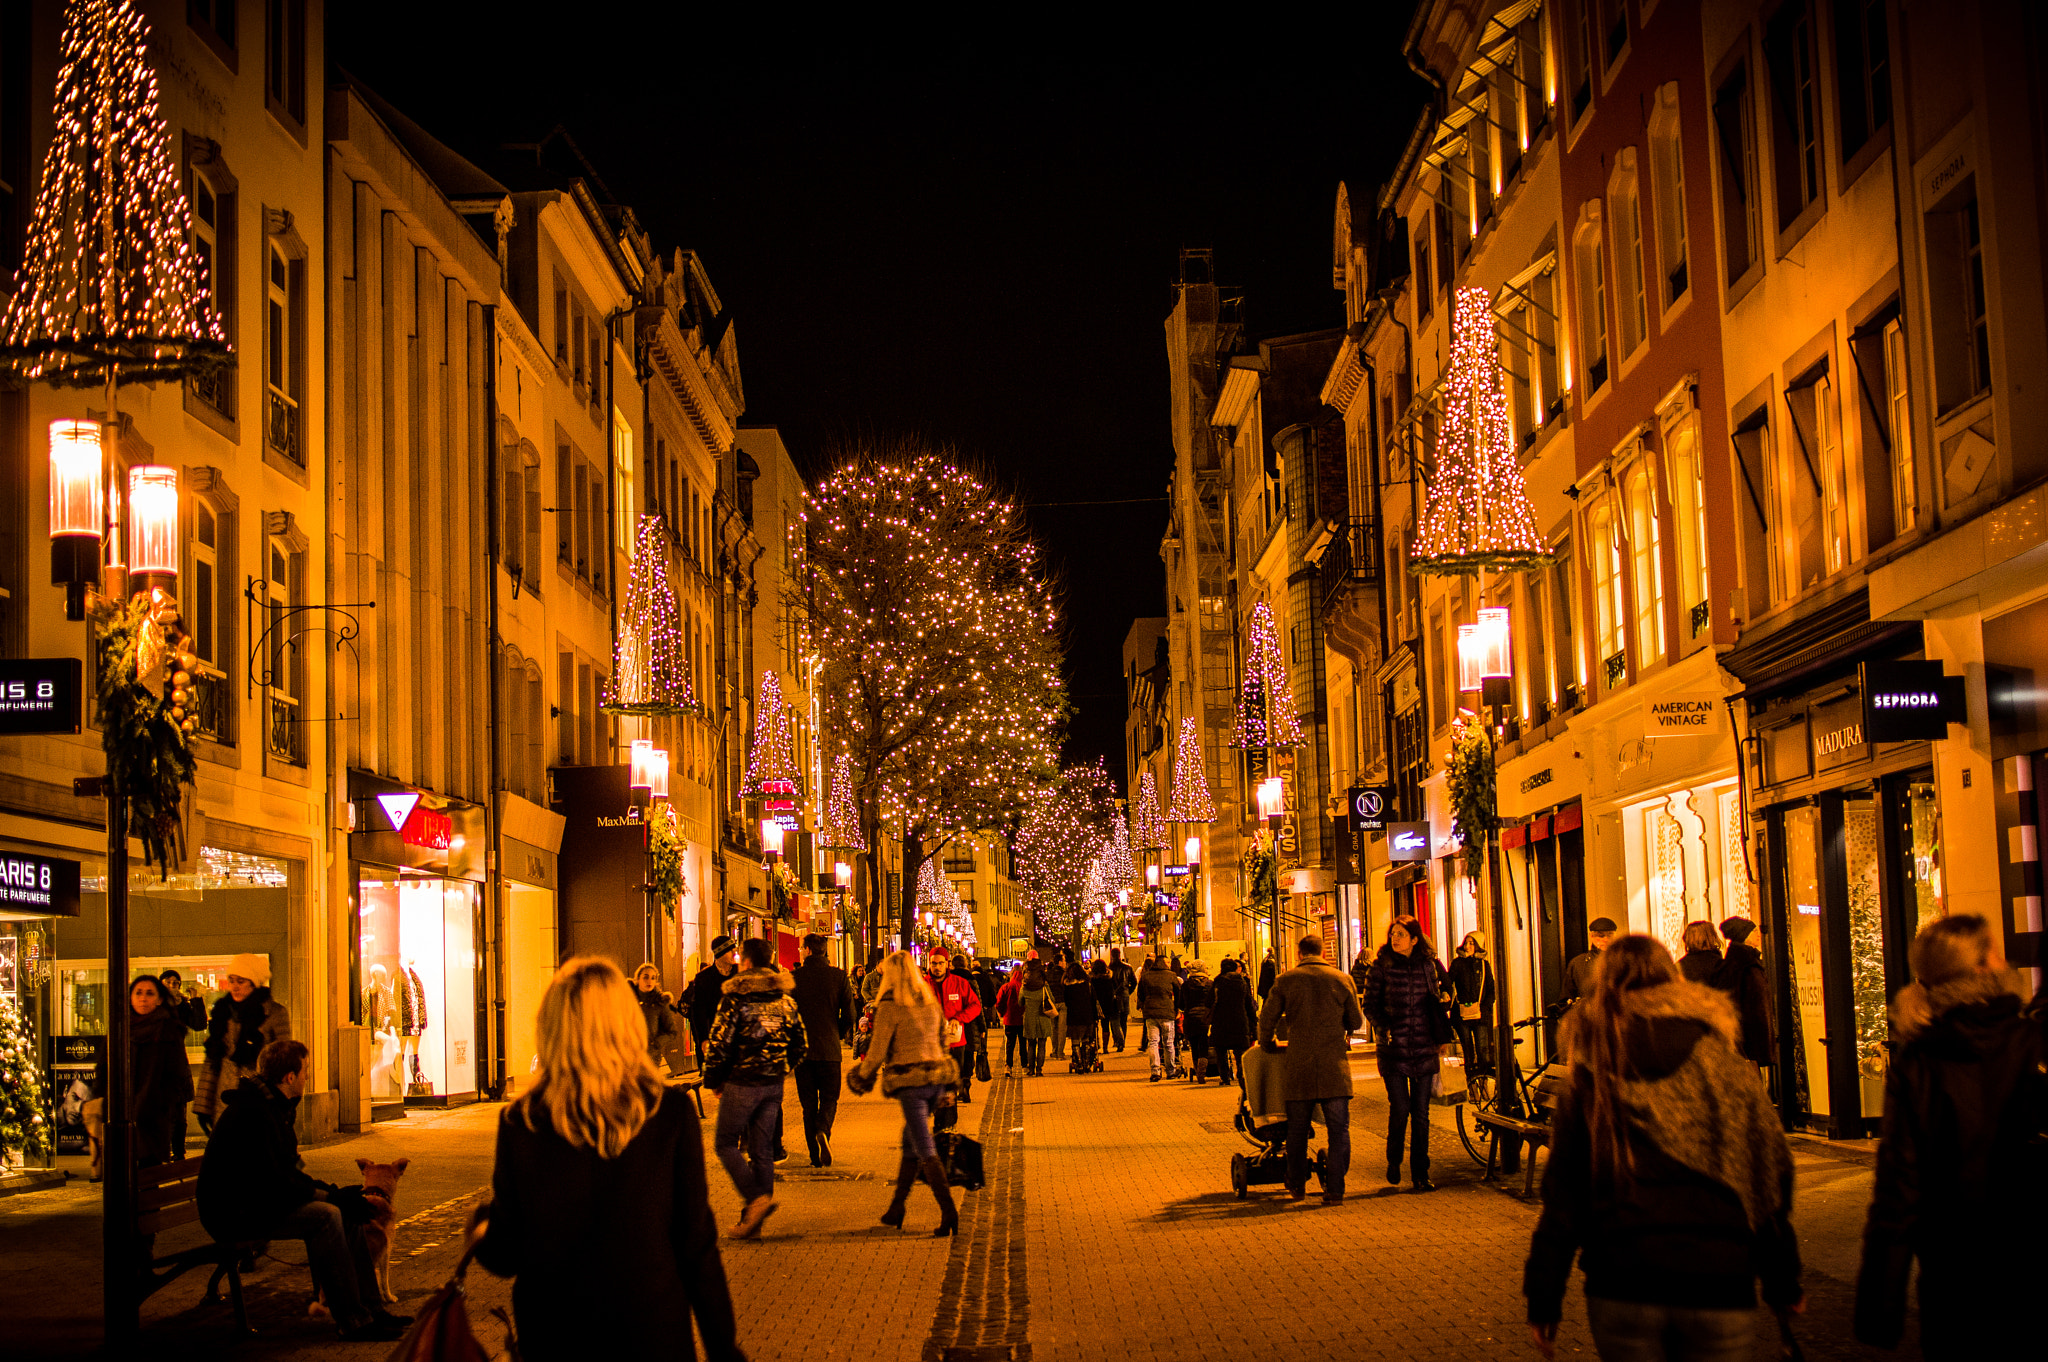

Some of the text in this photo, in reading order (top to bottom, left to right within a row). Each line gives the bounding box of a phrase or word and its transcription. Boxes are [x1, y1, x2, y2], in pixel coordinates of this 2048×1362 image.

[1931, 154, 1966, 194] SEPHORA
[37, 681, 54, 699] 8
[1651, 701, 1712, 714] AMERICAN
[1874, 692, 1939, 709] SEPHORA
[1658, 714, 1707, 726] VINTAGE
[1815, 724, 1863, 757] MADURA
[774, 815, 795, 823] tapis
[1360, 819, 1381, 828] neuhaus
[40, 864, 51, 890] 8
[10, 888, 51, 905] PARFUMERIE
